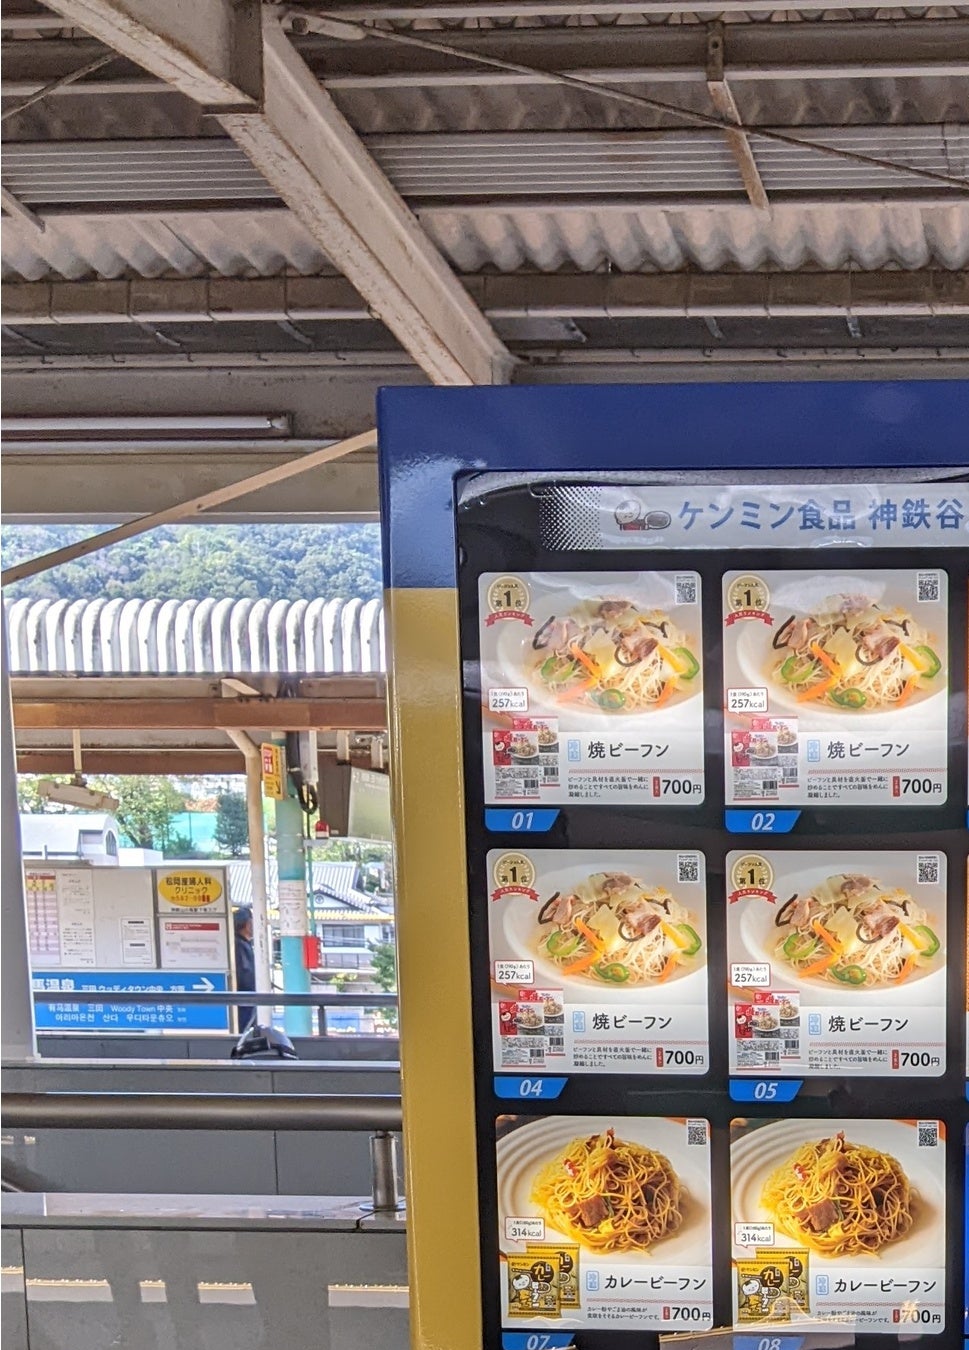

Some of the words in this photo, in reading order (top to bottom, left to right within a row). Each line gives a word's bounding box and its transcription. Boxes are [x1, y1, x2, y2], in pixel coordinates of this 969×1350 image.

[678, 500, 856, 532] ケンミン食品
[492, 698, 526, 708] 257kcal
[731, 699, 765, 708] 257kcal
[588, 741, 670, 759] 焼ビーフン
[827, 741, 910, 759] 焼ビーフン
[662, 779, 702, 794] 700円
[901, 778, 942, 794] 700円
[511, 811, 534, 830] 01
[751, 813, 776, 831] 02
[498, 971, 531, 980] 257kcal
[734, 973, 768, 983] 257kcal
[111, 1004, 135, 1014] Woody
[137, 1004, 156, 1013] Town
[592, 1012, 672, 1030] 焼ビーフン
[829, 1016, 909, 1033] 焼ビーフン
[665, 1050, 704, 1065] 700円
[901, 1052, 940, 1067] 700円
[520, 1079, 542, 1096] 04
[754, 1082, 778, 1099] 05
[511, 1227, 542, 1237] 314kcal
[741, 1233, 771, 1243] 314kcal
[604, 1275, 706, 1290] カレービーフン
[834, 1279, 937, 1293] カレービーフン
[672, 1307, 711, 1321] 700円
[902, 1310, 941, 1324] 700円
[526, 1335, 551, 1350] 07
